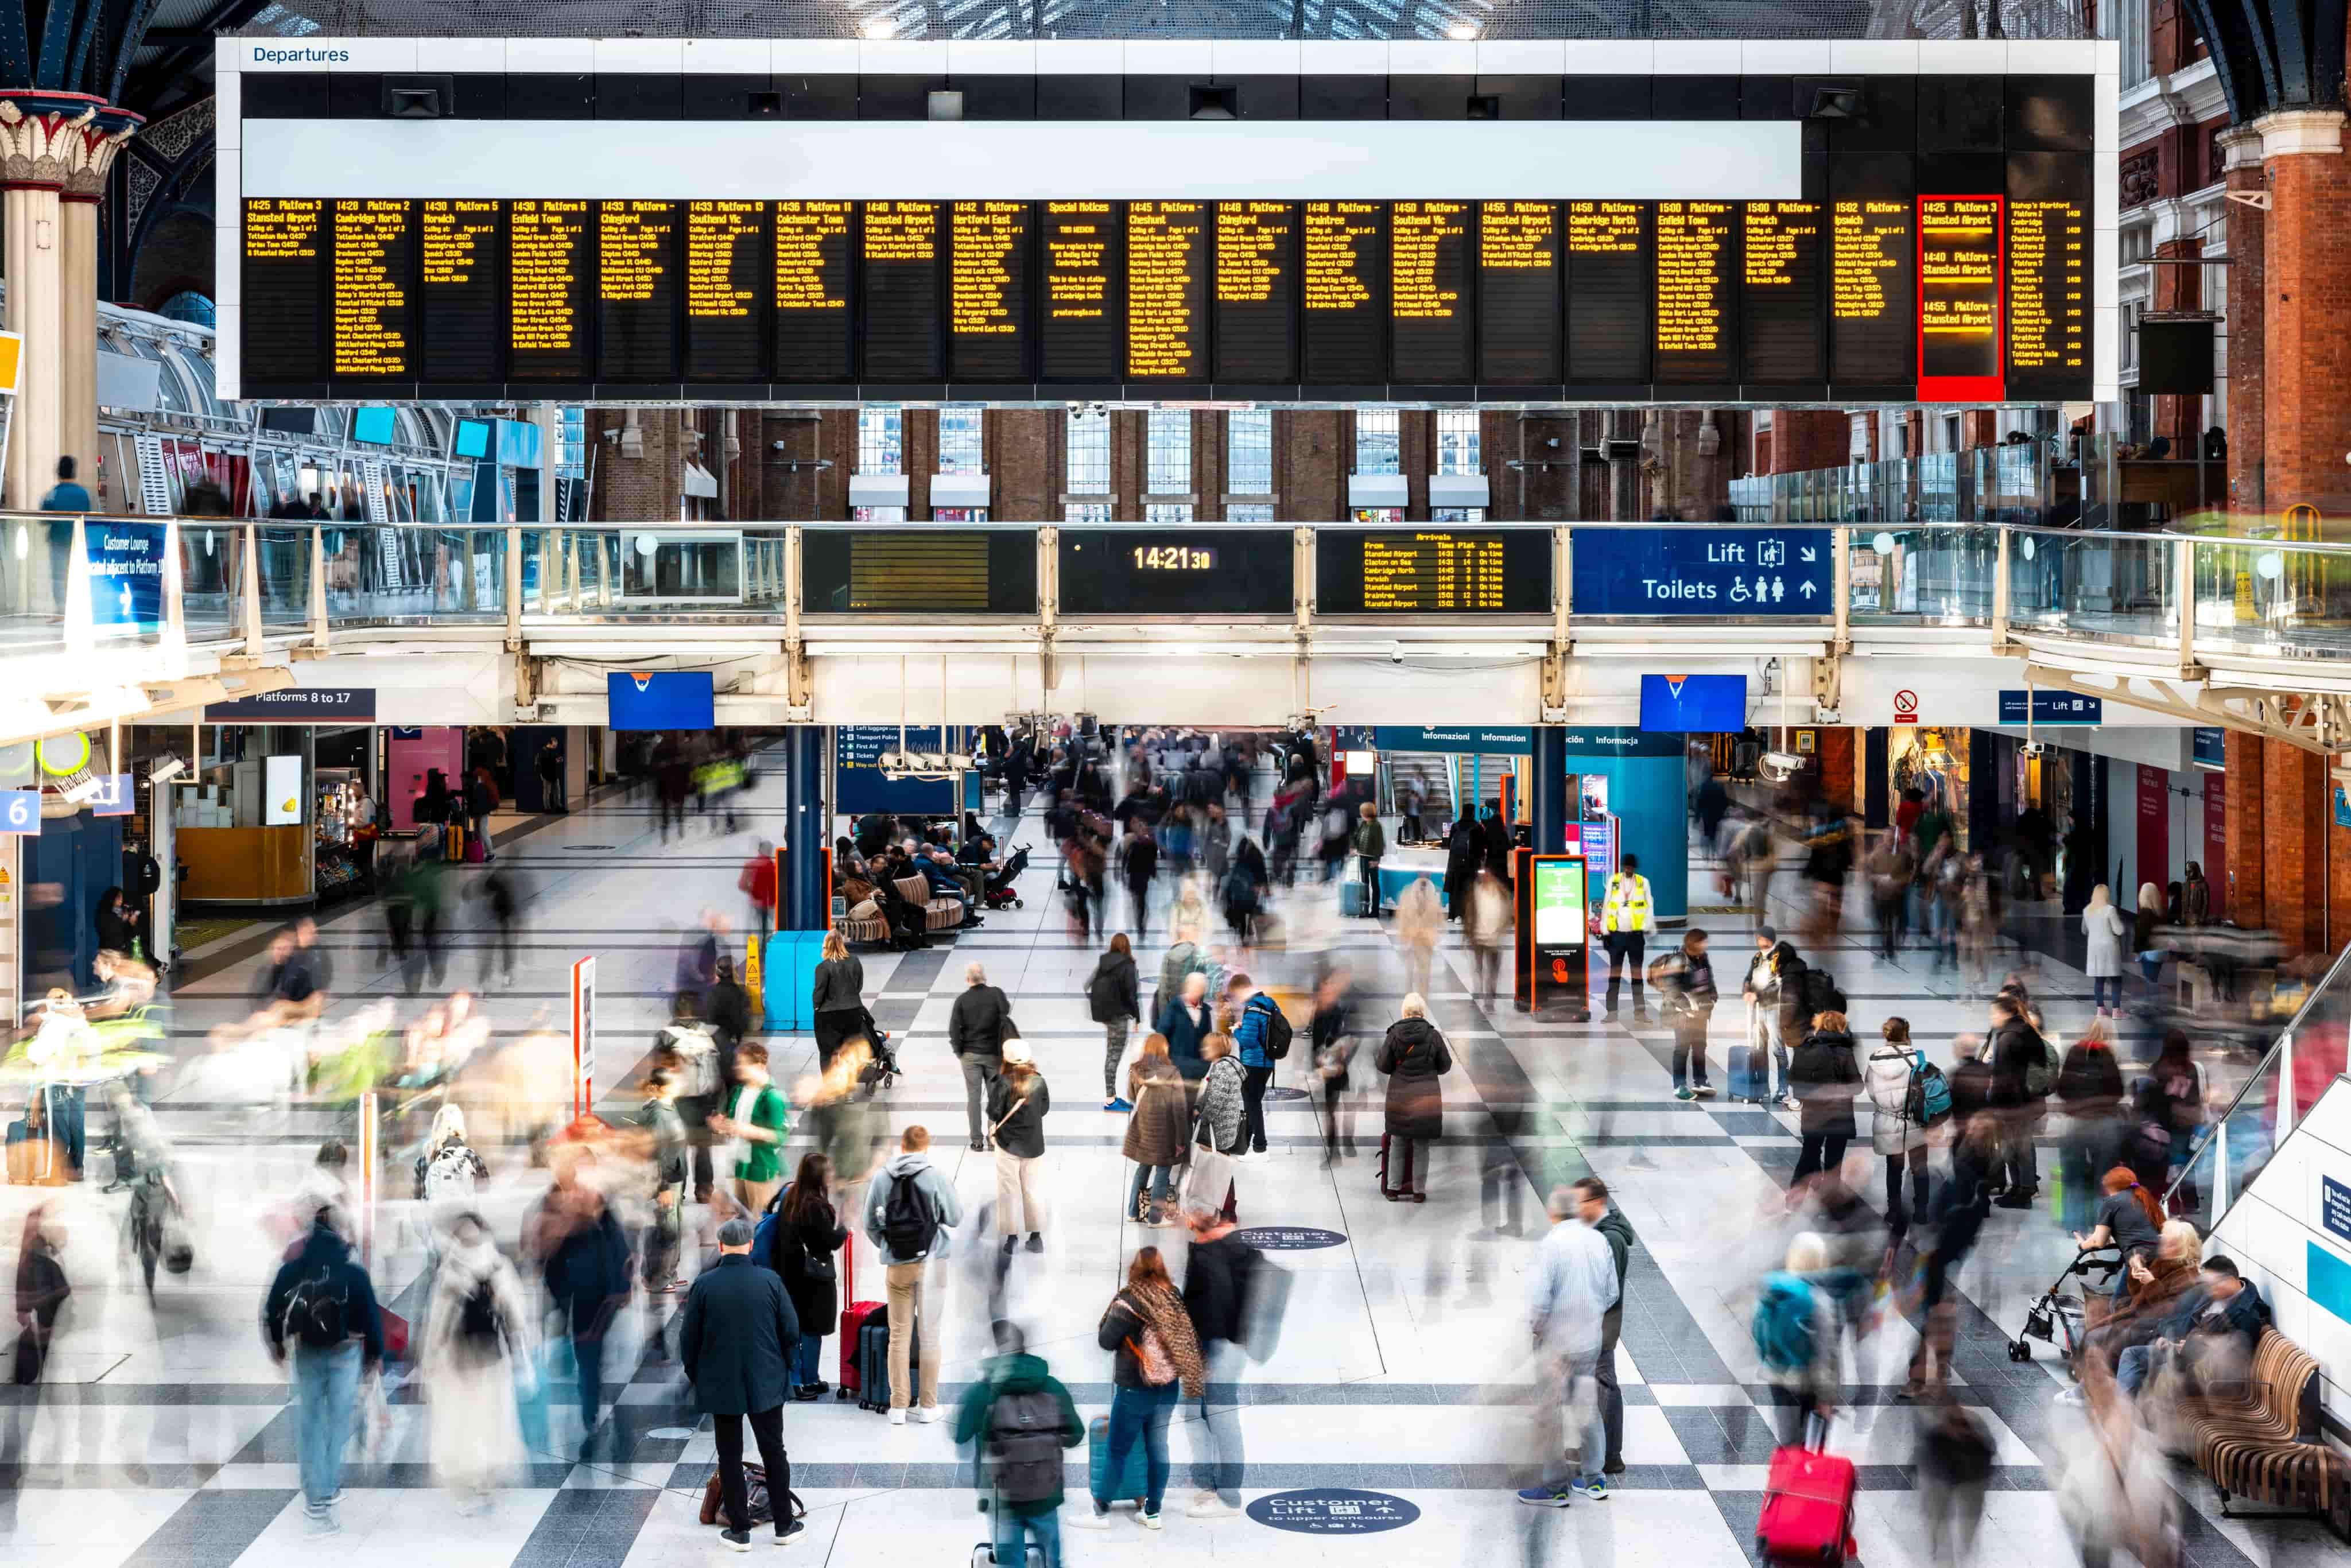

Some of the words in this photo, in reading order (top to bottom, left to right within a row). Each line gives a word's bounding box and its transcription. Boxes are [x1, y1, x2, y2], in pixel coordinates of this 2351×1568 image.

[255, 48, 348, 64] Departures
[279, 200, 314, 210] Platform
[315, 200, 322, 210] 3
[367, 201, 402, 210] Platform
[404, 201, 410, 210] 2
[455, 202, 490, 211] Platform
[492, 201, 498, 211] 5
[544, 202, 578, 211] Platform
[580, 202, 587, 211] 6
[633, 202, 667, 211] Platform
[717, 202, 752, 211] Platform
[755, 202, 763, 211] 13
[806, 202, 841, 211] Platform
[844, 202, 852, 211] 11
[897, 202, 932, 212] Platform
[985, 202, 1020, 211] Platform
[1049, 203, 1077, 213] Special
[1078, 202, 1109, 211] Notices
[1161, 203, 1195, 211] Platform
[1250, 203, 1284, 212] Platform
[1337, 203, 1372, 212] Platform
[1425, 203, 1460, 212] Platform
[1514, 203, 1549, 212] Platform
[1601, 203, 1636, 212] Platform
[1689, 203, 1724, 212] Platform
[1778, 203, 1813, 212] Platform
[1866, 203, 1902, 212] Platform
[1923, 203, 1946, 212] 14:25
[1954, 203, 1989, 212] Platform
[1991, 203, 1997, 212] 3
[247, 213, 285, 222] Stansted
[286, 213, 317, 223] Airport
[335, 214, 376, 224] Cambridge
[378, 214, 402, 223] North
[424, 214, 455, 223] Norwich
[512, 214, 539, 223] Enfield
[541, 214, 562, 223] Town
[600, 214, 640, 224] Chingford
[689, 214, 727, 224] Southend
[729, 214, 742, 224] Vic
[777, 215, 821, 224] Colchester
[823, 215, 844, 224] Town
[865, 215, 902, 224] Stansted
[904, 215, 934, 224] Airport
[953, 215, 990, 224] Hertford
[991, 215, 1011, 224] East
[1129, 215, 1167, 224] Cheshunt
[1218, 215, 1257, 224] Chingford
[1306, 216, 1345, 225] Braintree
[1393, 215, 1431, 225] Southend
[1433, 215, 1446, 225] Vic
[1482, 215, 1520, 224] Stansted
[1521, 215, 1551, 225] Airport
[1570, 215, 1610, 225] Cambridge
[1612, 216, 1636, 225] North
[1658, 216, 1685, 225] Enfield
[1687, 216, 1709, 225] Town
[1746, 216, 1778, 224] Norwich
[1834, 216, 1864, 225] Ipswich
[1922, 215, 1960, 224] Stansted
[1961, 215, 1992, 225] Airport
[1924, 253, 1946, 262] 14:40
[1954, 253, 1989, 262] Platform
[1922, 265, 1960, 274] Stansted
[1961, 265, 1992, 275] Airport
[1924, 302, 1946, 311] 14:55
[1954, 301, 1989, 311] Platform
[1922, 314, 1961, 324] Stansted
[1961, 313, 1992, 324] Airport
[104, 534, 130, 550] Customer
[130, 535, 149, 553] Lounge
[1708, 544, 1745, 562] Lift
[1135, 547, 1188, 569] 14:21
[1191, 552, 1211, 569] 30
[107, 558, 129, 579] adjacent
[130, 561, 135, 574] to
[137, 558, 157, 574] Platform
[1643, 579, 1717, 599] Toilets
[256, 692, 308, 701] Platforms
[311, 693, 319, 703] 8
[321, 694, 333, 703] to
[336, 693, 351, 703] 17
[2053, 702, 2068, 710] Lift
[1423, 732, 1470, 740] Informazioni
[1481, 733, 1526, 742] Information
[1596, 736, 1638, 746] Informacja
[9, 797, 28, 825] 6
